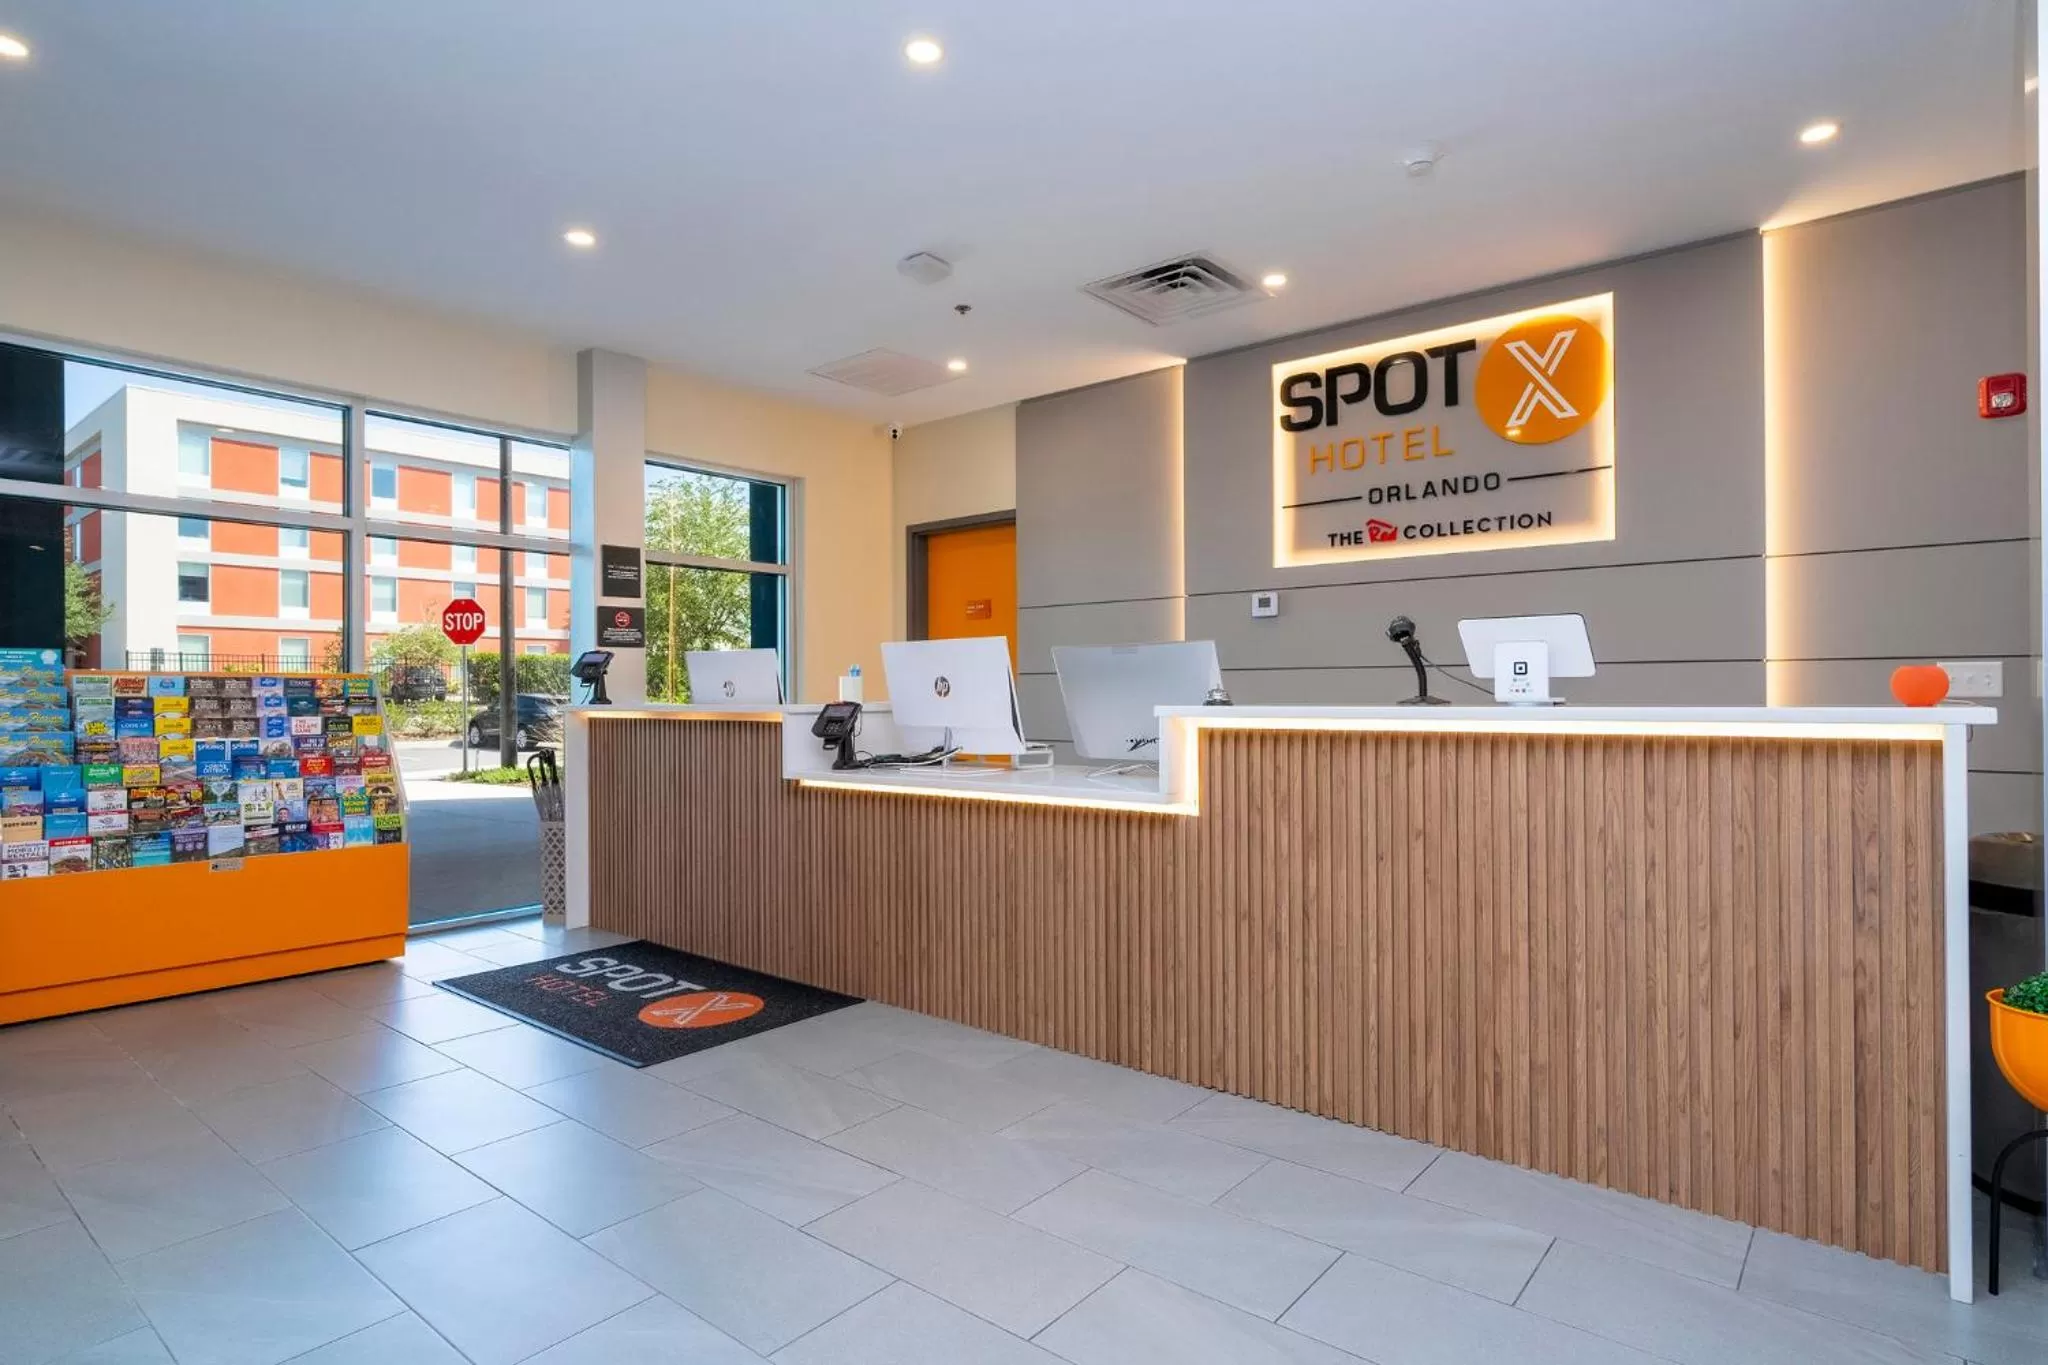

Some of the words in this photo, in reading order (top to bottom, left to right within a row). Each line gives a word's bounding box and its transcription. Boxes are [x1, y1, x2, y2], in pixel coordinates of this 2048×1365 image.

[1280, 339, 1477, 433] SPOT
[1504, 328, 1580, 428] X
[1308, 424, 1456, 475] HOTEL
[1368, 472, 1501, 505] ORLANDO
[1328, 531, 1364, 547] THE
[1403, 511, 1553, 540] COLLECTION
[445, 612, 483, 630] STOP
[526, 972, 613, 1008] HOTEL
[556, 957, 707, 999] SPOT
